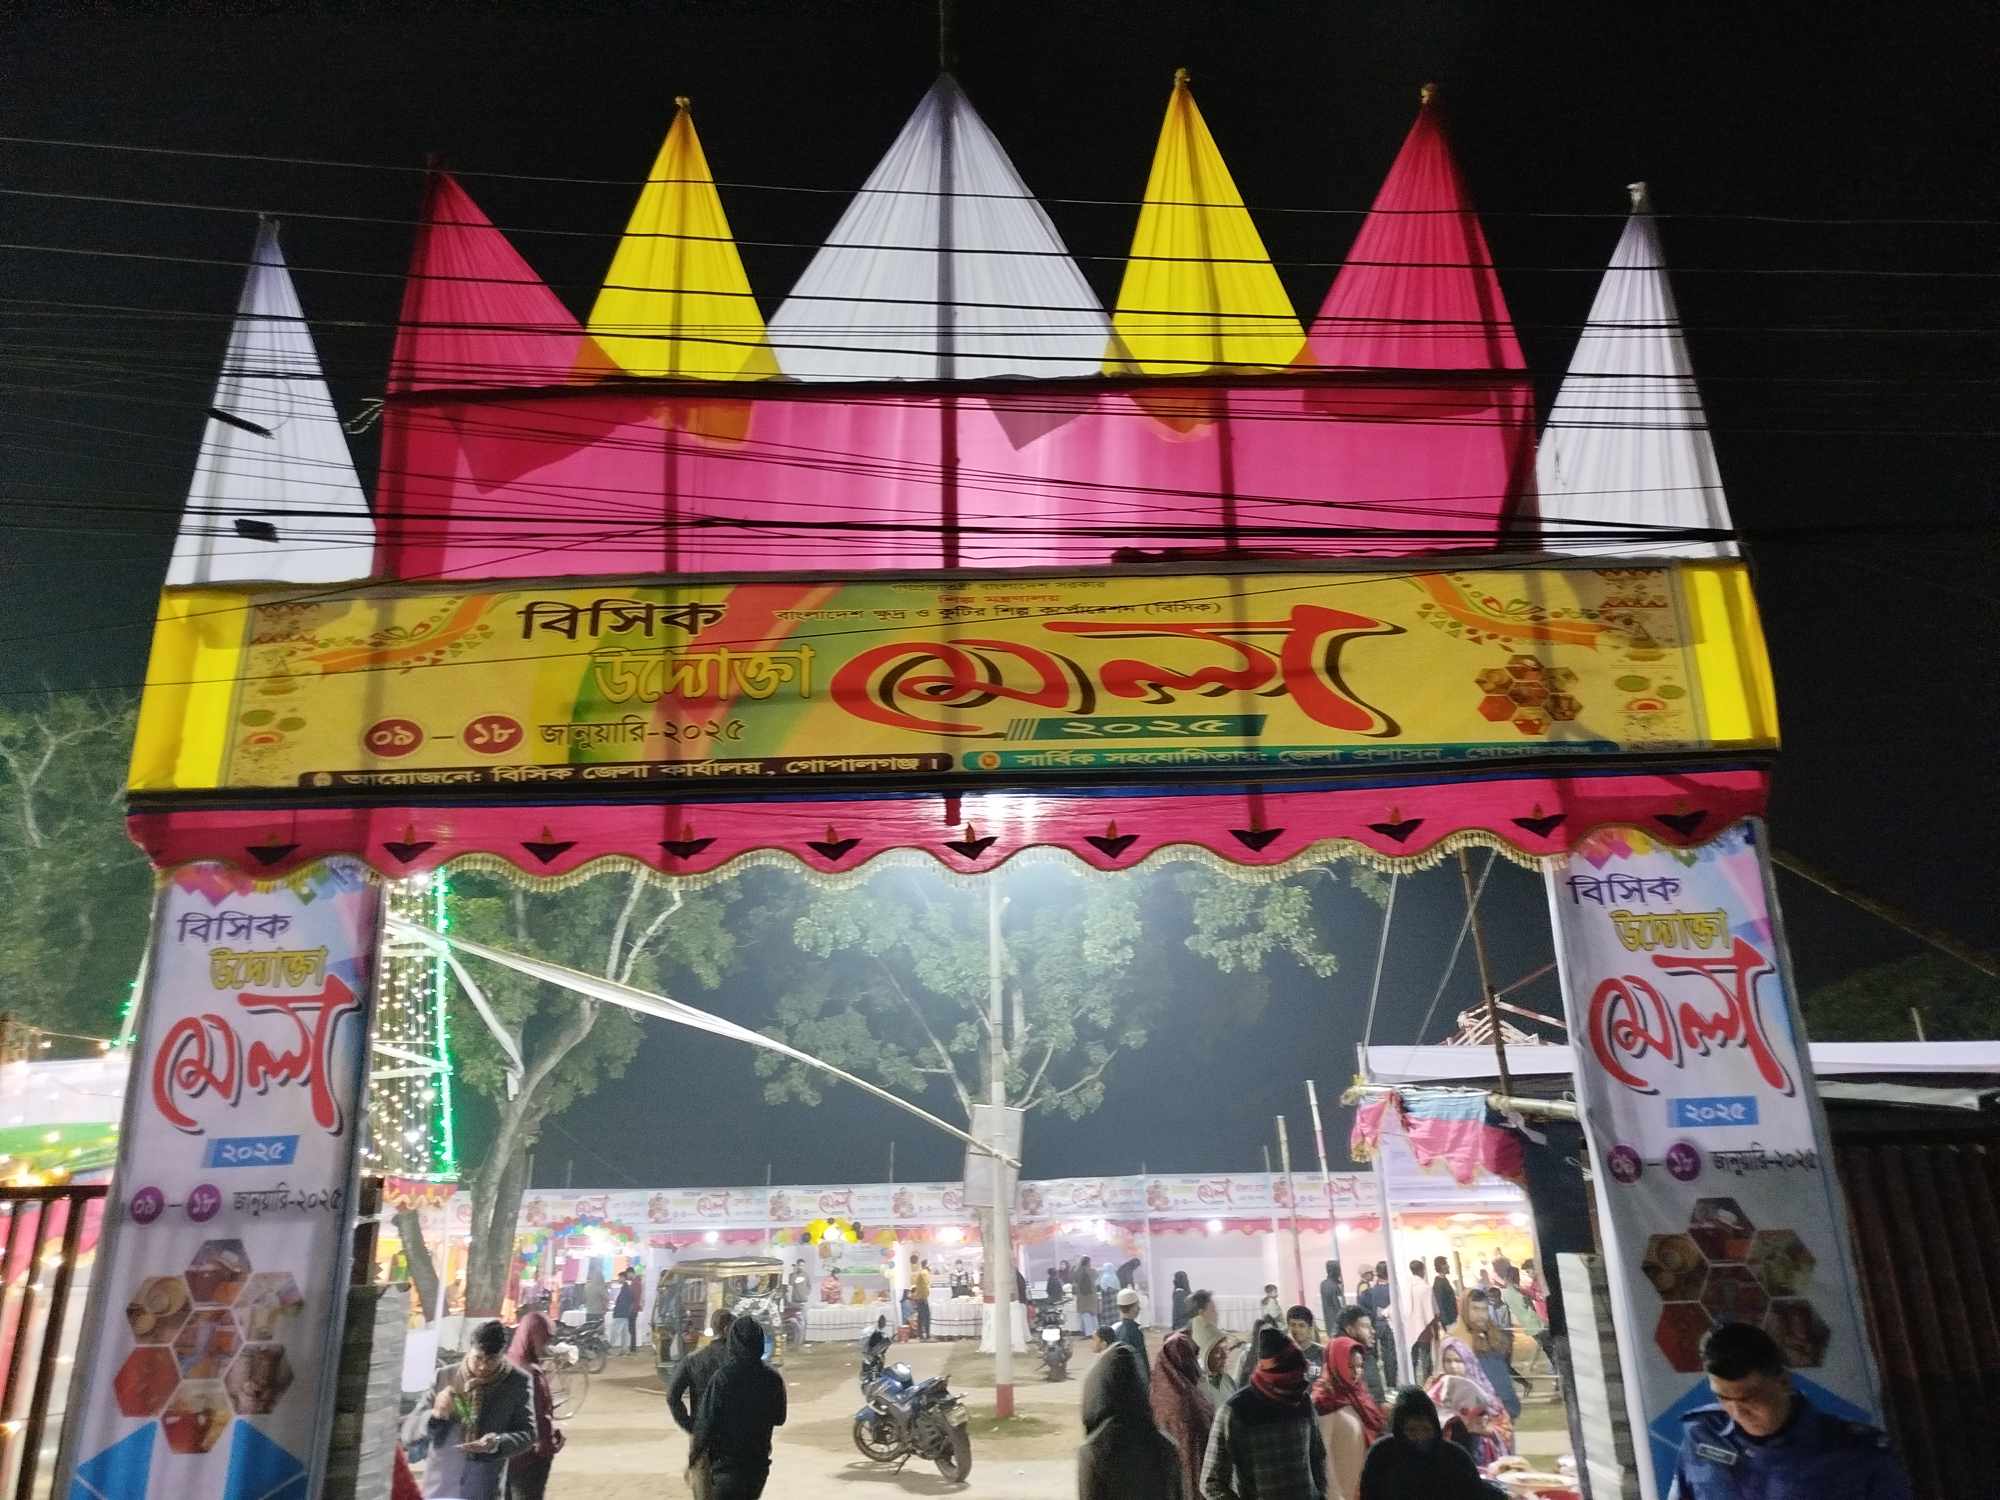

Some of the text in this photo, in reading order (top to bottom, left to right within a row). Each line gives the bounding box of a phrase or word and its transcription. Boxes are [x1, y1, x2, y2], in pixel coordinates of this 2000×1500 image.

[516, 598, 727, 641] বিসিক
[915, 609, 930, 618] ও
[1144, 601, 1222, 614] (বিসিক)
[587, 642, 817, 704] উদ্যোক্তা
[830, 604, 1407, 741] মেলা
[372, 727, 414, 747] ০৯
[473, 720, 519, 746] ১৮
[538, 715, 749, 751] জানুয়ারি-২০২৫
[1061, 719, 1232, 737] ২০২৫
[342, 769, 482, 786] আয়োজনে:
[491, 766, 573, 783] বিসিক
[581, 763, 651, 780] জেলা
[785, 756, 921, 774] গোপালগঞ্জ
[1014, 750, 1096, 767] সার্বিক
[1566, 873, 1681, 906] বিসিক
[176, 910, 295, 943] বিসিক
[1608, 906, 1731, 952] উদ্যোক্তা
[208, 944, 330, 990] উদ্যোক্তা
[1588, 935, 1797, 1097] মেলা
[153, 973, 364, 1138] মেলা
[1685, 1102, 1748, 1121] ২০২৫
[221, 1140, 287, 1162] ২০২৫
